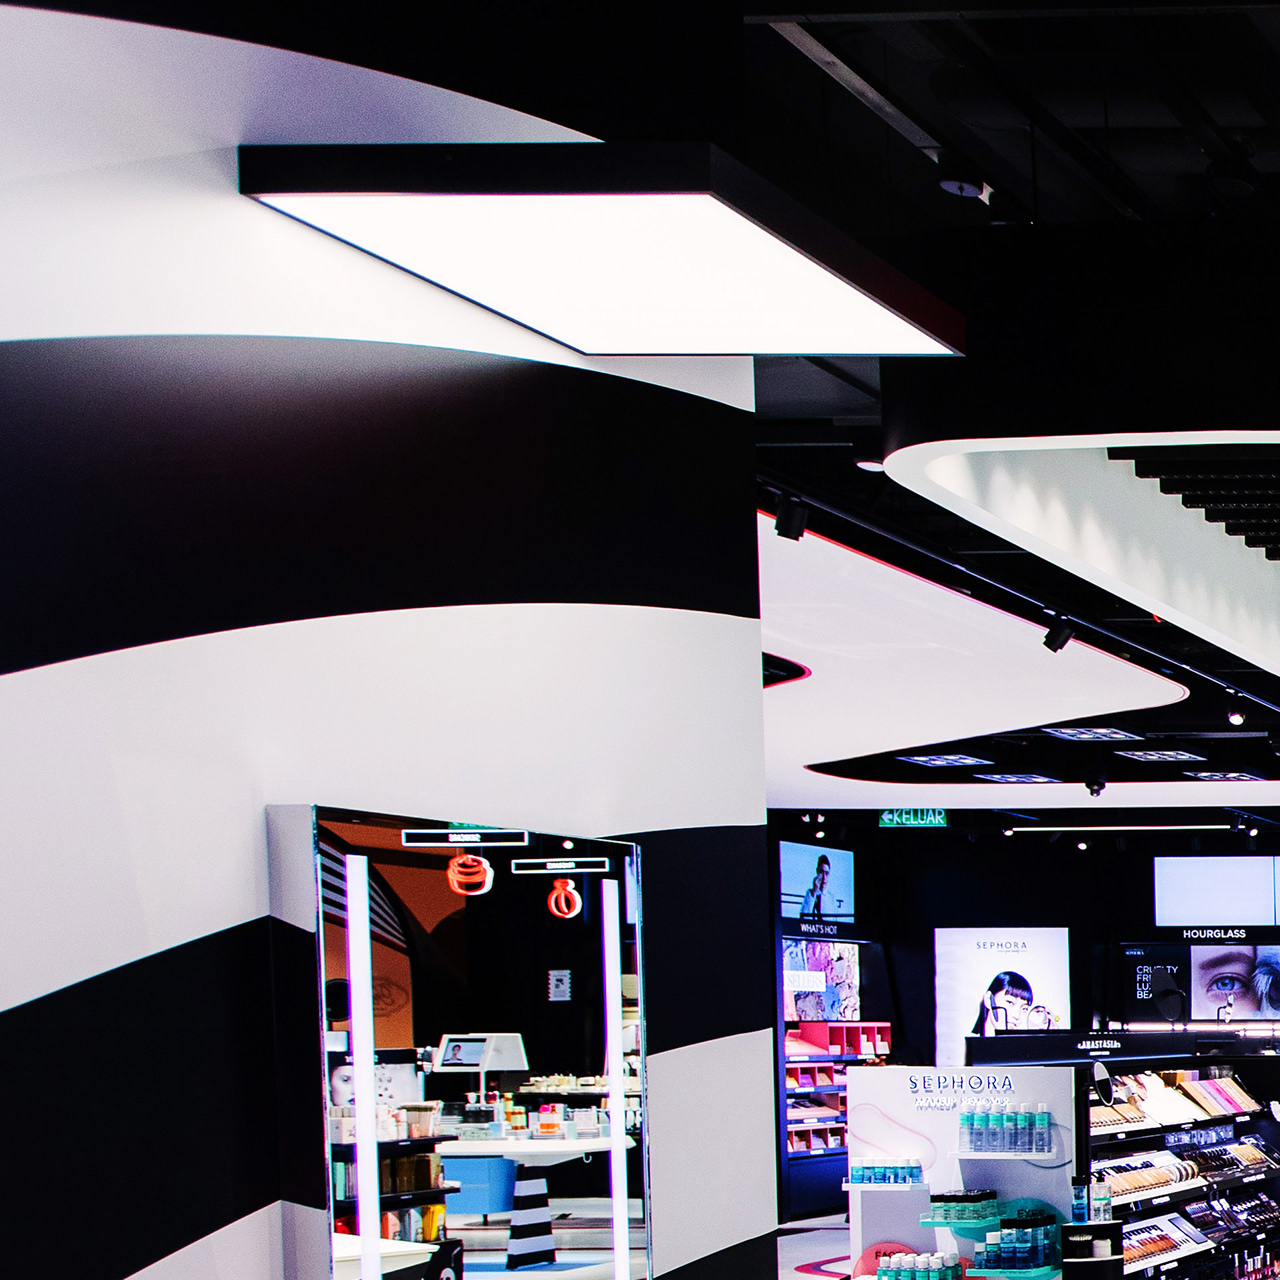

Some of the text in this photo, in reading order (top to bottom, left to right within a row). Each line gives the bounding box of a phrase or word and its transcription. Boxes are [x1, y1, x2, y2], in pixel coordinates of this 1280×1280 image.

[893, 808, 945, 825] KELUAR
[800, 923, 838, 935] WHAT'S HOT
[1183, 929, 1247, 939] HOURGLASS
[976, 941, 1027, 949] SEPHORA
[1079, 1040, 1120, 1049] ANASTASIA
[908, 1074, 1014, 1090] SEPHORA
